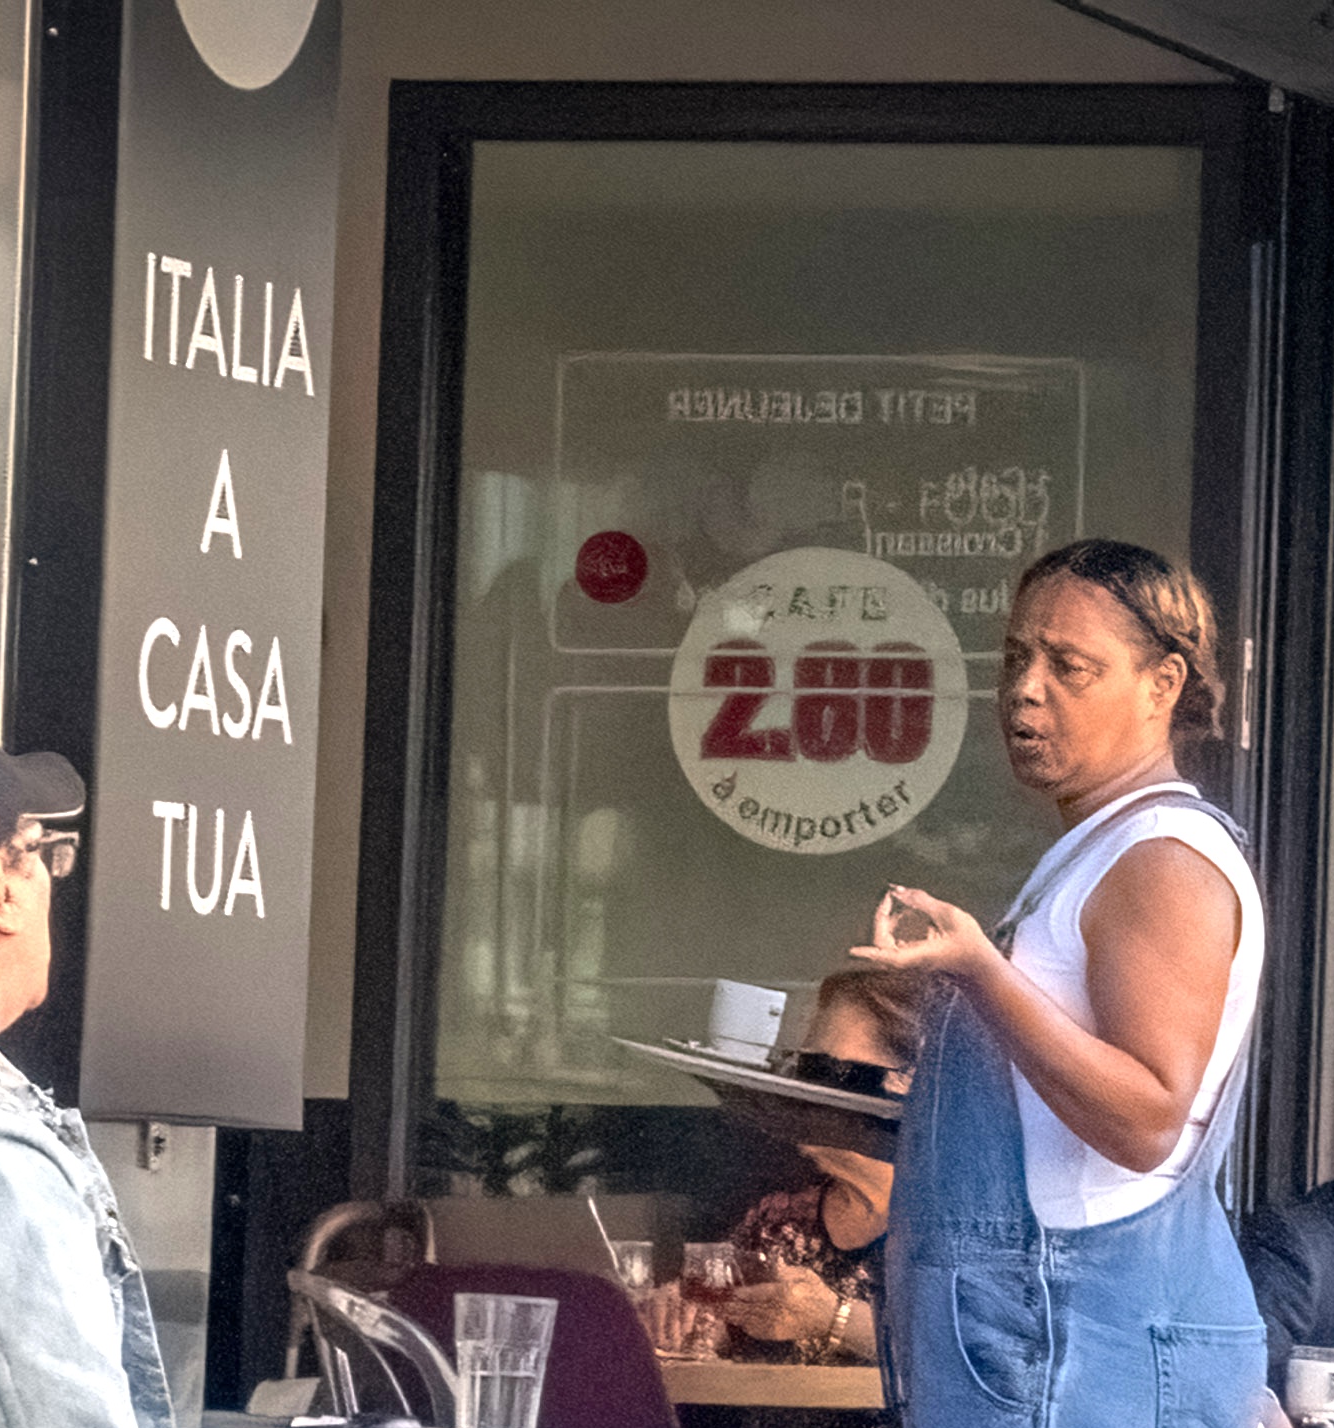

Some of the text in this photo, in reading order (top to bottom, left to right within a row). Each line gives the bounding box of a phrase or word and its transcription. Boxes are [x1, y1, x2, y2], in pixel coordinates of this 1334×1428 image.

[143, 252, 315, 397] ITALIA
[200, 449, 243, 560] A
[139, 617, 293, 745] CASA
[153, 800, 265, 919] TUA
[739, 779, 912, 848] emporter
